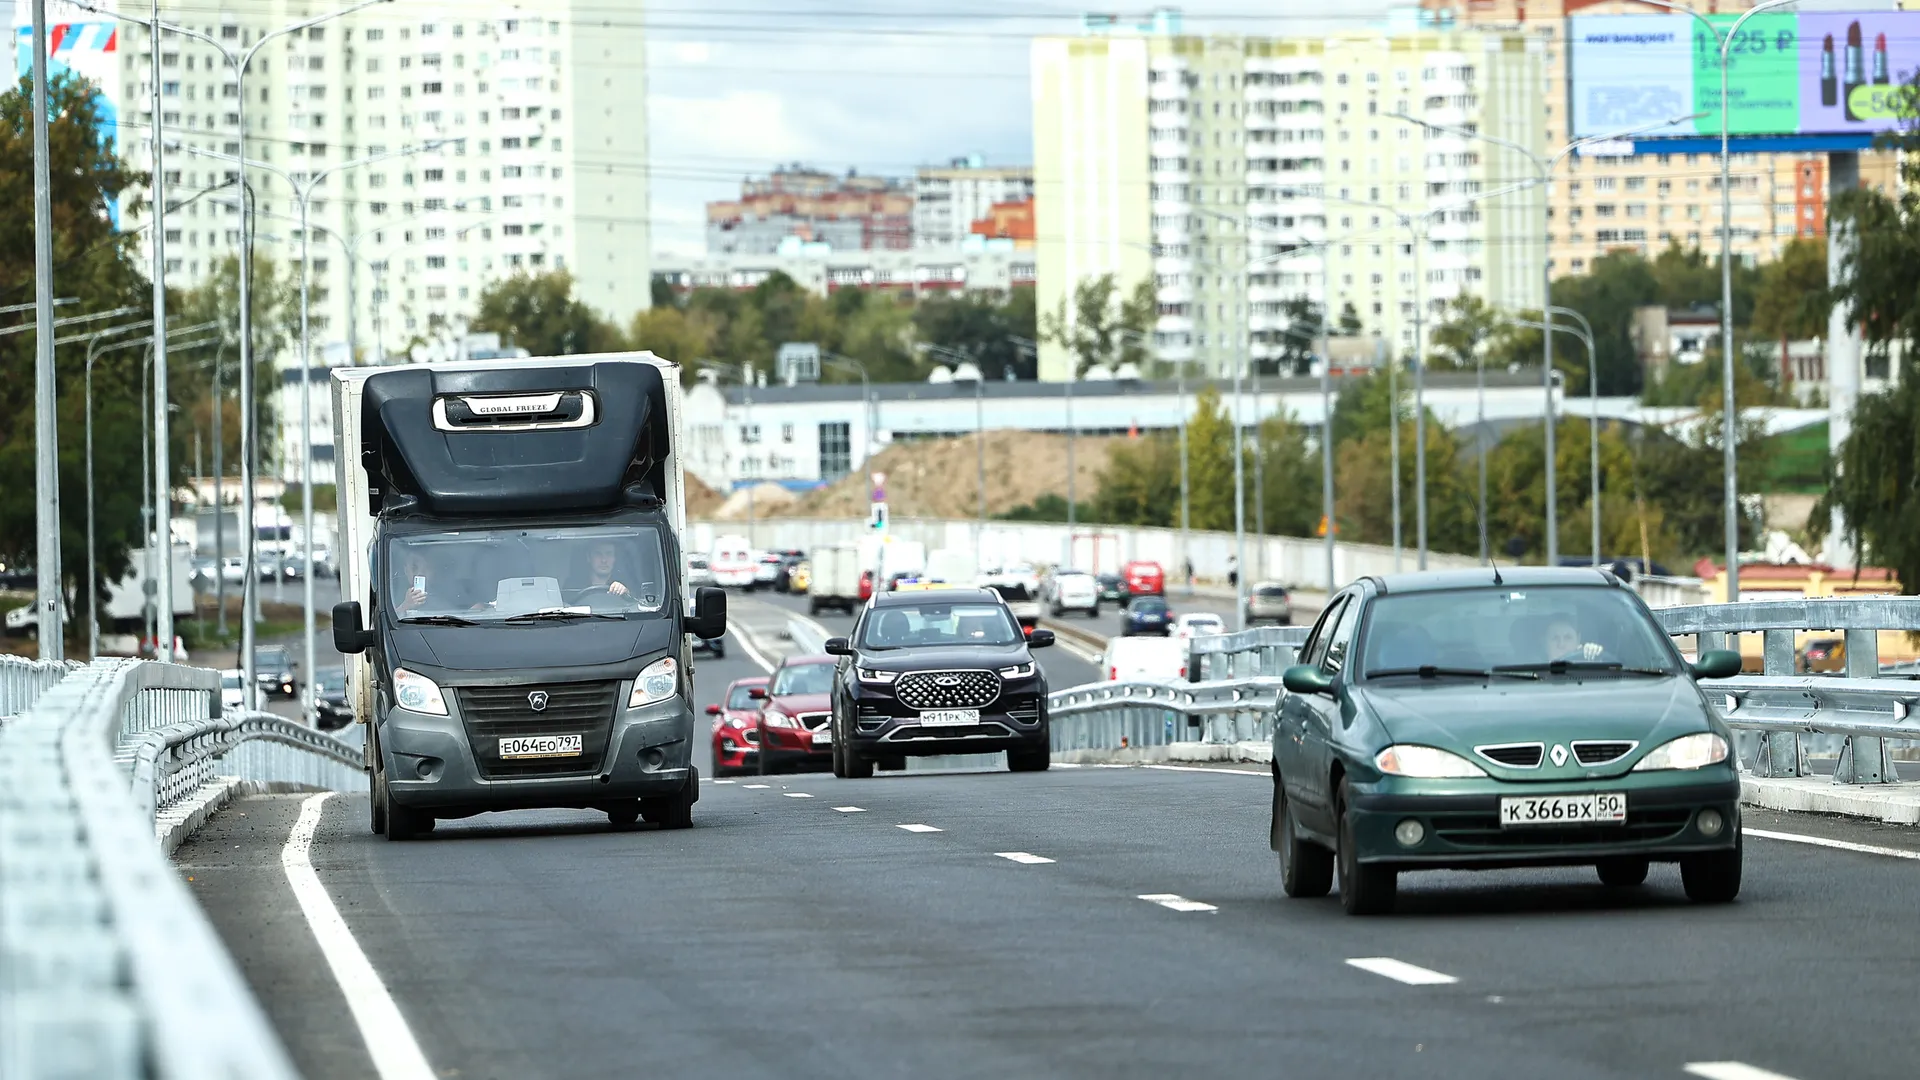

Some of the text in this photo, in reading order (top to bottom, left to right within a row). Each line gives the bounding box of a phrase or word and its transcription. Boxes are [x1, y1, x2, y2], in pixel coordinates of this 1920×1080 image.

[515, 404, 548, 412] FREEZE
[504, 736, 578, 753] Е064ЕО 797
[1599, 797, 1618, 811] 50
